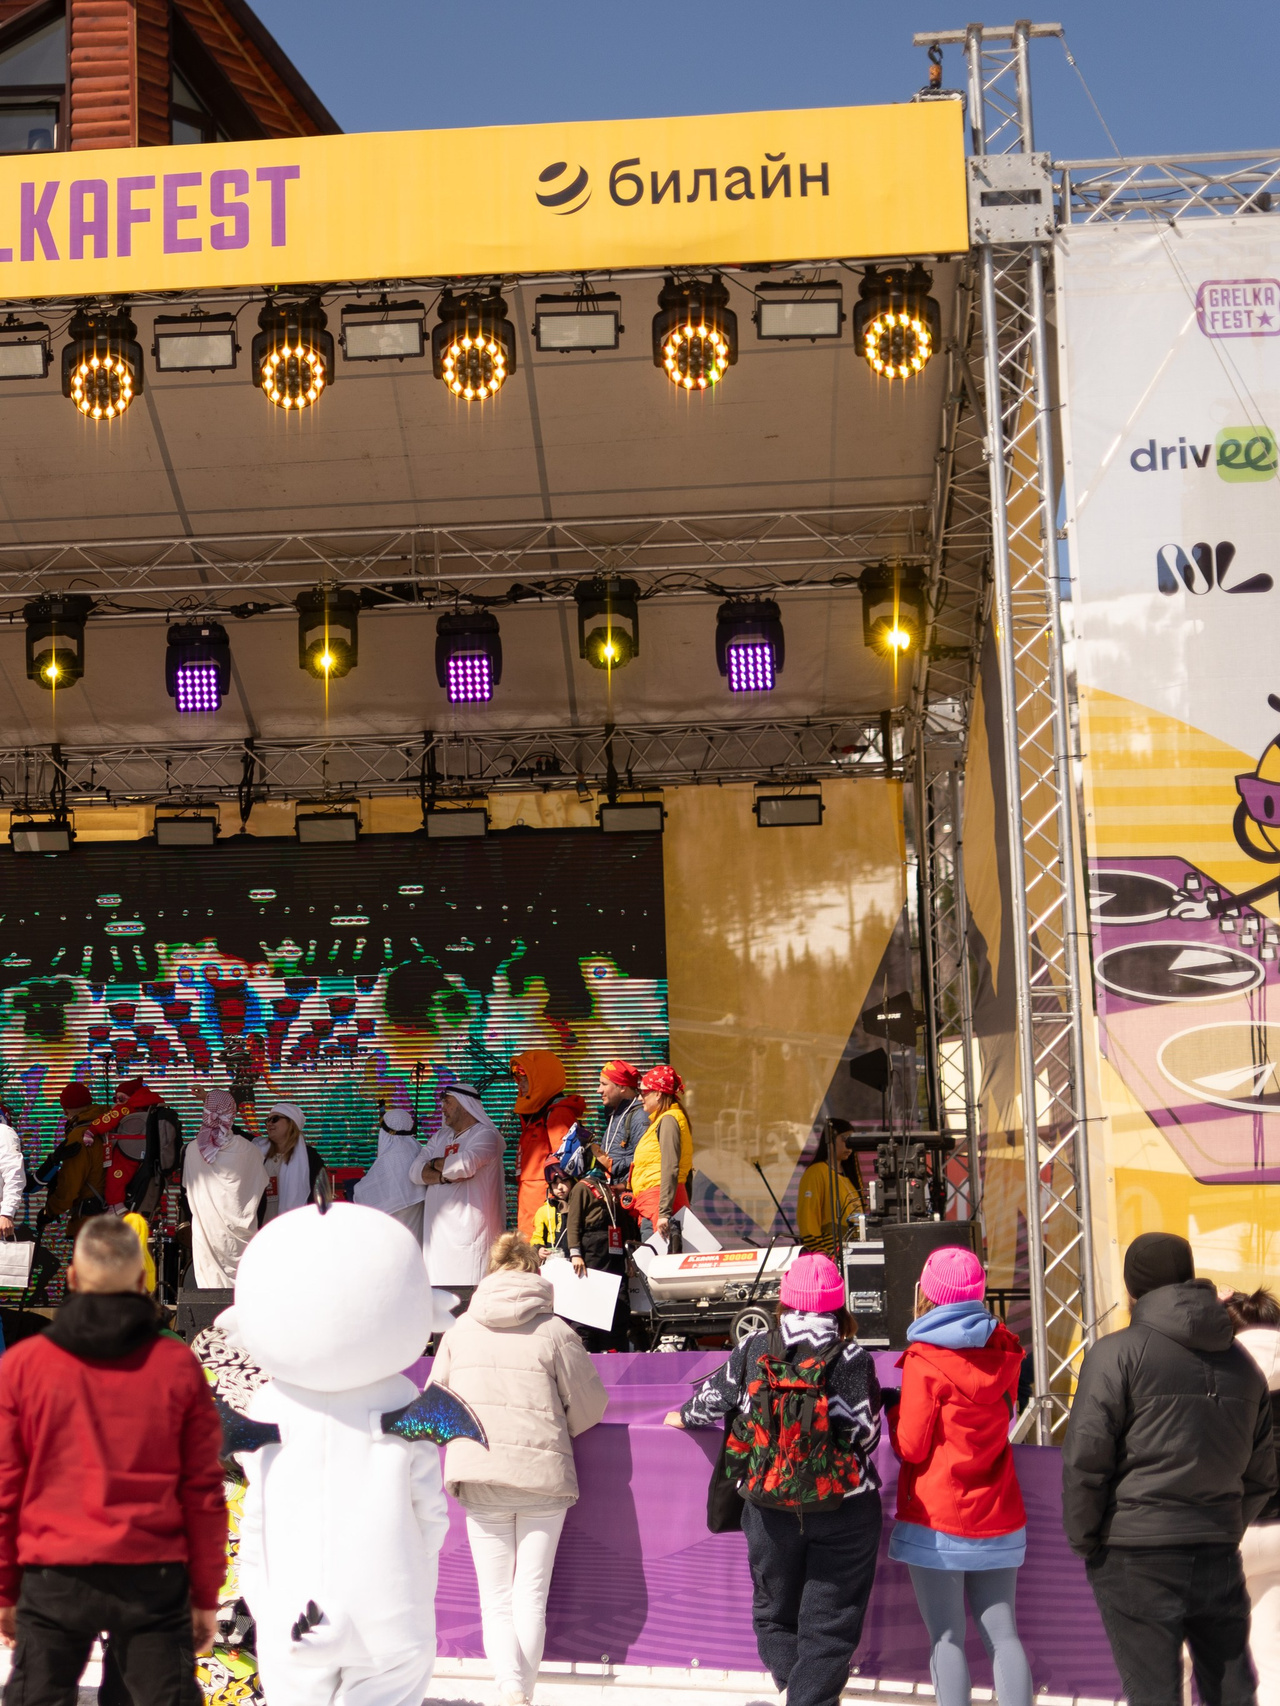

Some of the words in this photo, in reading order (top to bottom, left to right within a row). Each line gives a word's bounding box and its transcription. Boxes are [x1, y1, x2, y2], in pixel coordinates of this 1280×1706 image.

[609, 152, 830, 206] билайн
[1209, 287, 1275, 307] GRELKA
[1211, 310, 1254, 329] FEST
[1130, 436, 1278, 473] drivee
